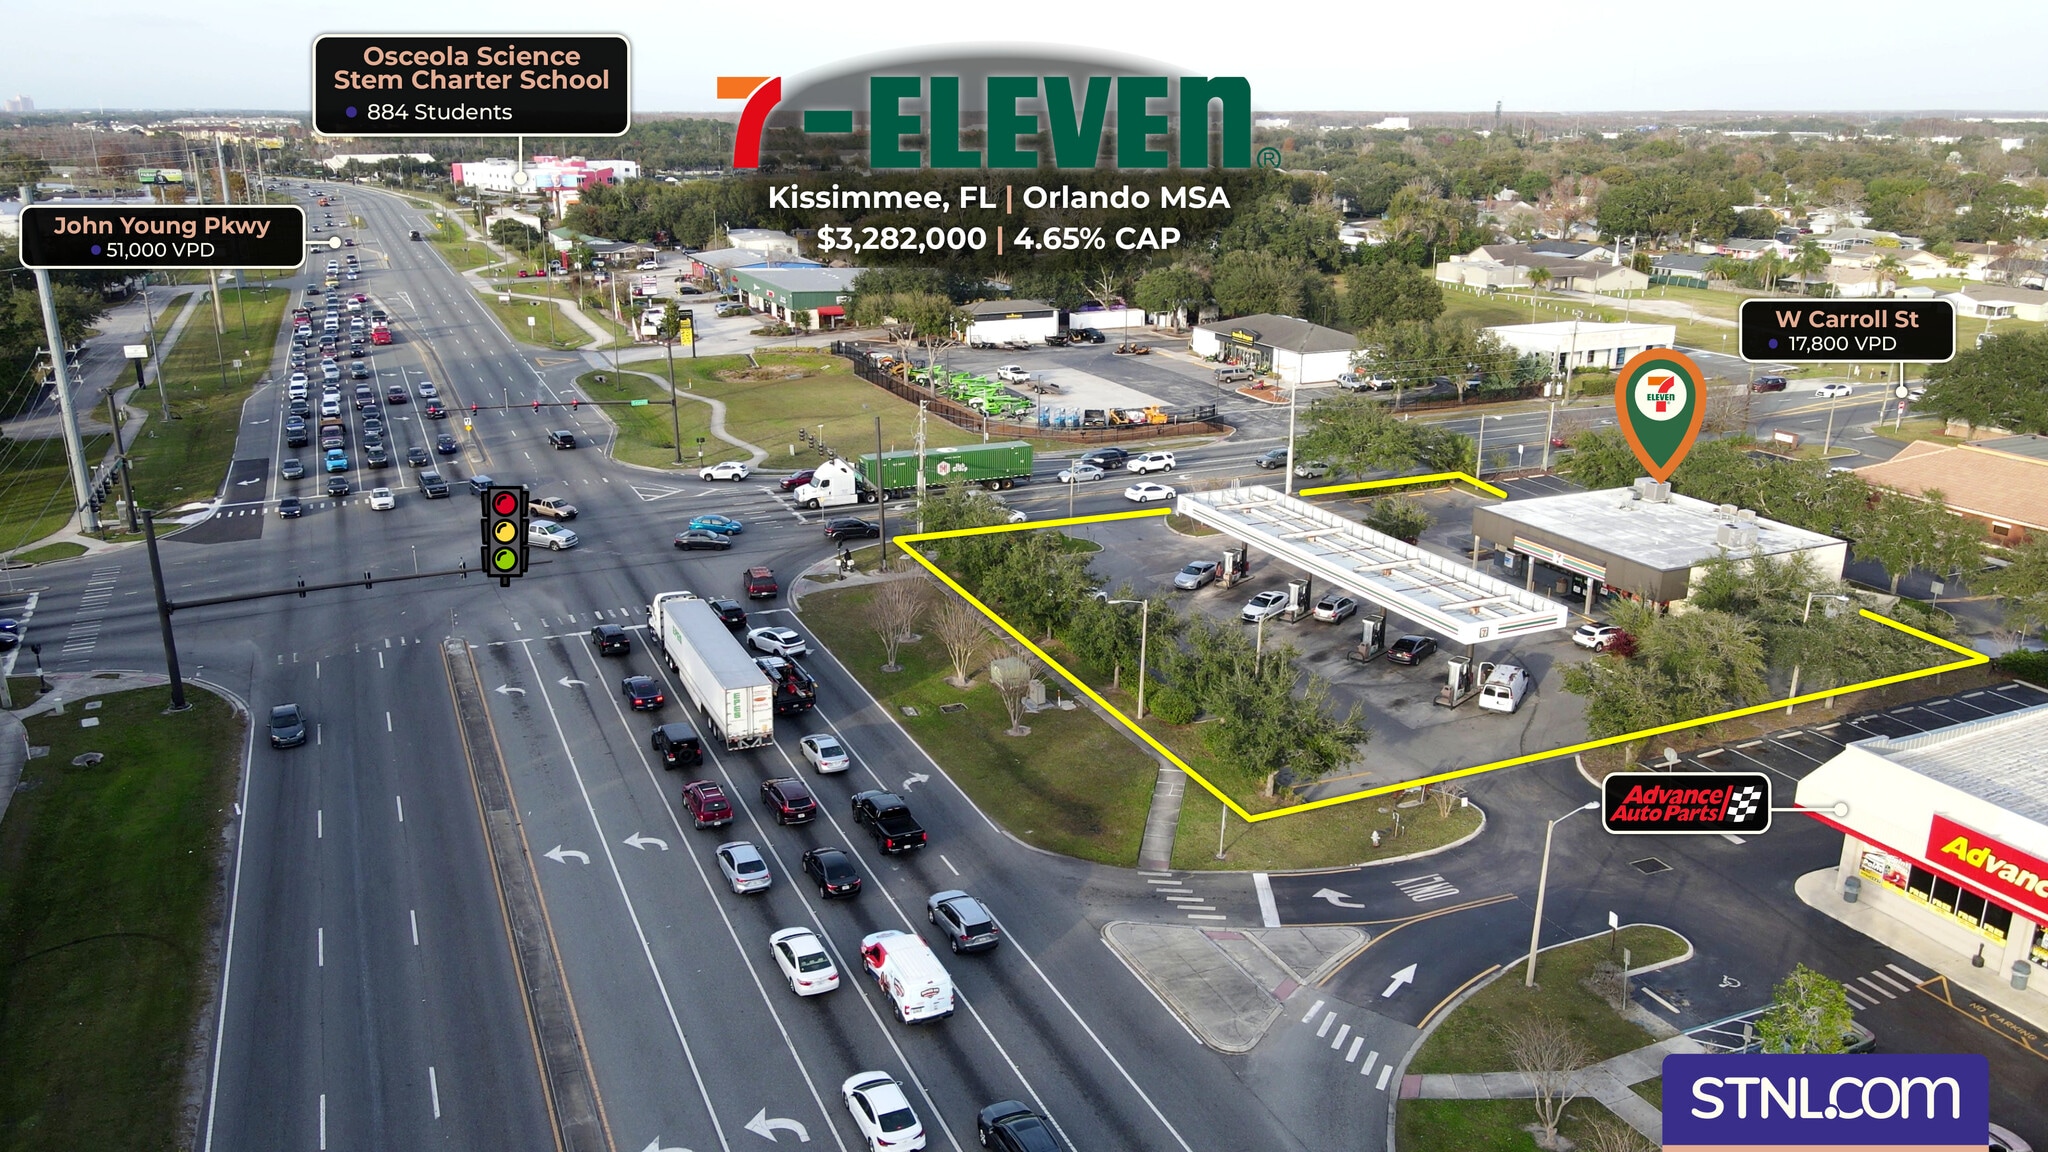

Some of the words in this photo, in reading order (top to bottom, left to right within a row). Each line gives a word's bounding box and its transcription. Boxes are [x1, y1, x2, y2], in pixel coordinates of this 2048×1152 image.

[1391, 873, 1460, 902] ONLY
[1969, 1002, 1988, 1013] NO
[1989, 1012, 2039, 1041] PARKING
